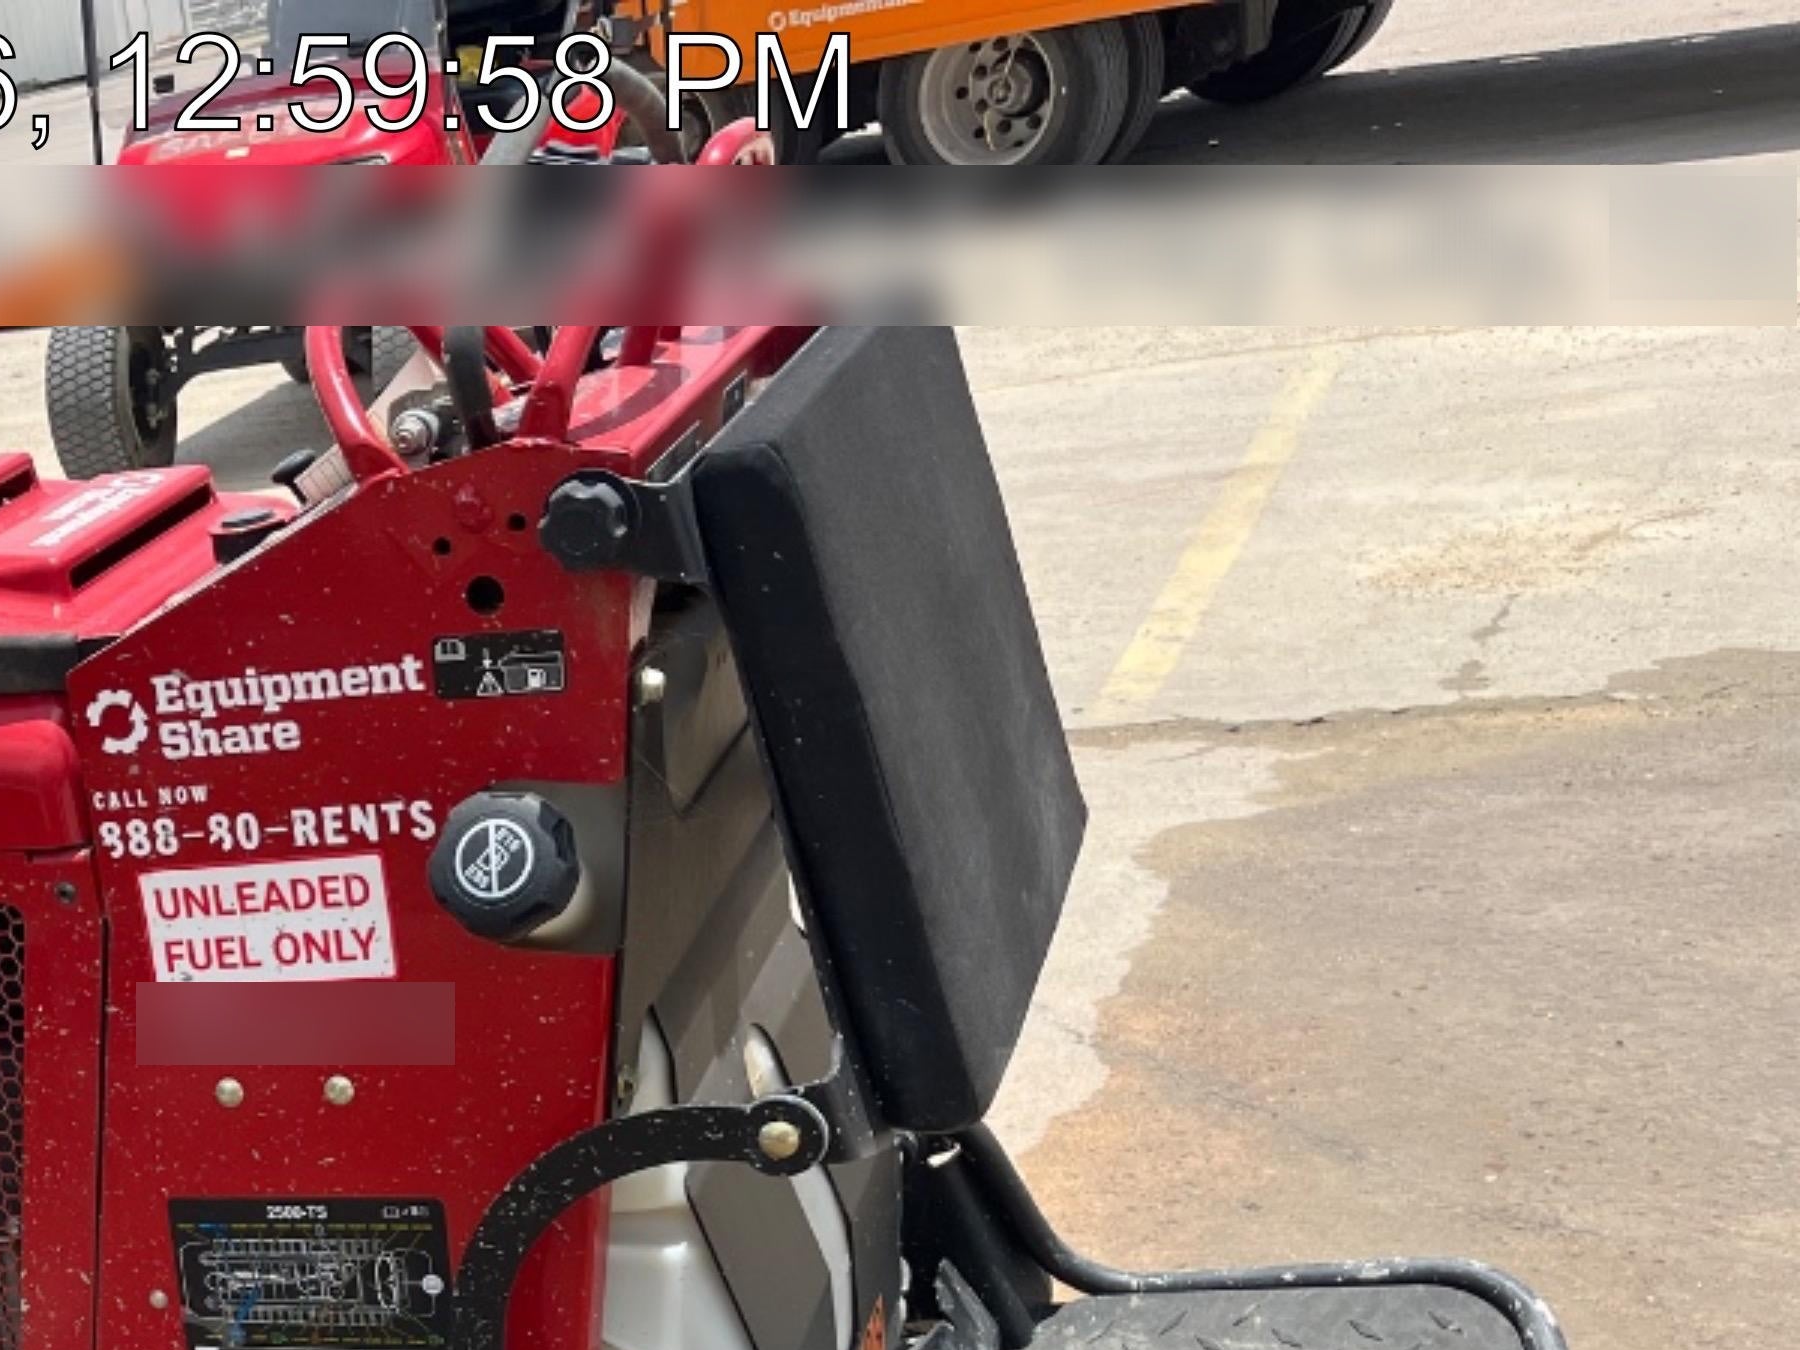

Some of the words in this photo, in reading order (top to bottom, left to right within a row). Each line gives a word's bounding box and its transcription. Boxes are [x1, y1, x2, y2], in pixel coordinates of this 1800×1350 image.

[151, 654, 425, 718] Equipment
[157, 719, 301, 760] Share
[92, 788, 149, 811] CALL
[158, 784, 208, 805] NOW
[153, 874, 370, 920] UNLEADED
[163, 936, 262, 973] FUEL
[271, 926, 377, 967] ONLY
